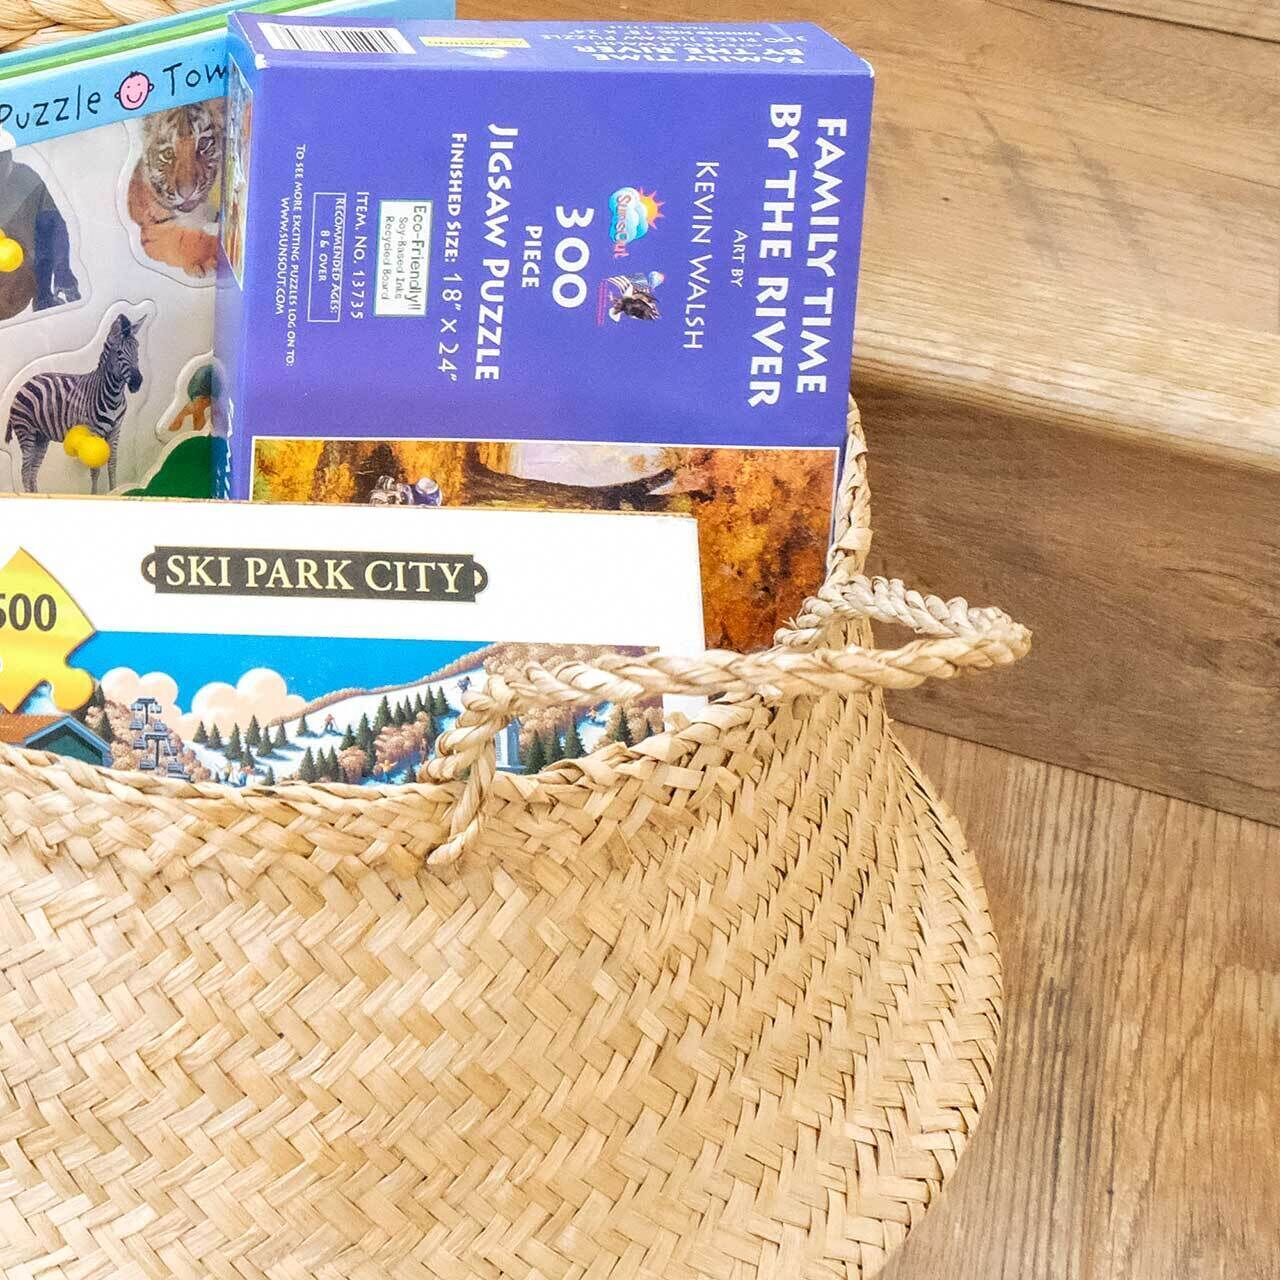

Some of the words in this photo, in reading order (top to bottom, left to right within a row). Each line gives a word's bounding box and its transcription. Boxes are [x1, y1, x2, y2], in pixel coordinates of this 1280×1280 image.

[162, 62, 228, 97] Tow
[296, 144, 306, 160] TO
[768, 104, 802, 159] BY
[295, 162, 305, 179] SEE
[448, 133, 467, 216] FINISHED
[483, 123, 519, 248] JIGSAW
[293, 182, 304, 211] MORE
[355, 191, 370, 230] ITEM.
[691, 161, 720, 244] KEVIN
[759, 170, 798, 258] THE
[806, 118, 847, 277] FAMILY
[275, 197, 290, 314] WWW.SUNSOUT.COM
[290, 214, 301, 261] EXCITING
[332, 197, 346, 281] RECOMMENDED
[444, 221, 462, 262] SIZE:
[522, 225, 543, 288] PIECE
[552, 206, 595, 309] 300
[731, 229, 749, 263] ART
[288, 264, 299, 306] PUZZLES
[318, 253, 328, 282] OVER
[731, 268, 744, 288] BY
[287, 308, 297, 328] LOG
[350, 270, 366, 320] 13735
[474, 259, 510, 380] PUZZLE
[683, 254, 713, 349] WALSH
[287, 331, 296, 348] ON
[747, 277, 789, 407] RIVER
[796, 287, 834, 393] TIME
[165, 554, 232, 589] SKI
[244, 557, 354, 591] PARK
[364, 560, 466, 594] CITY
